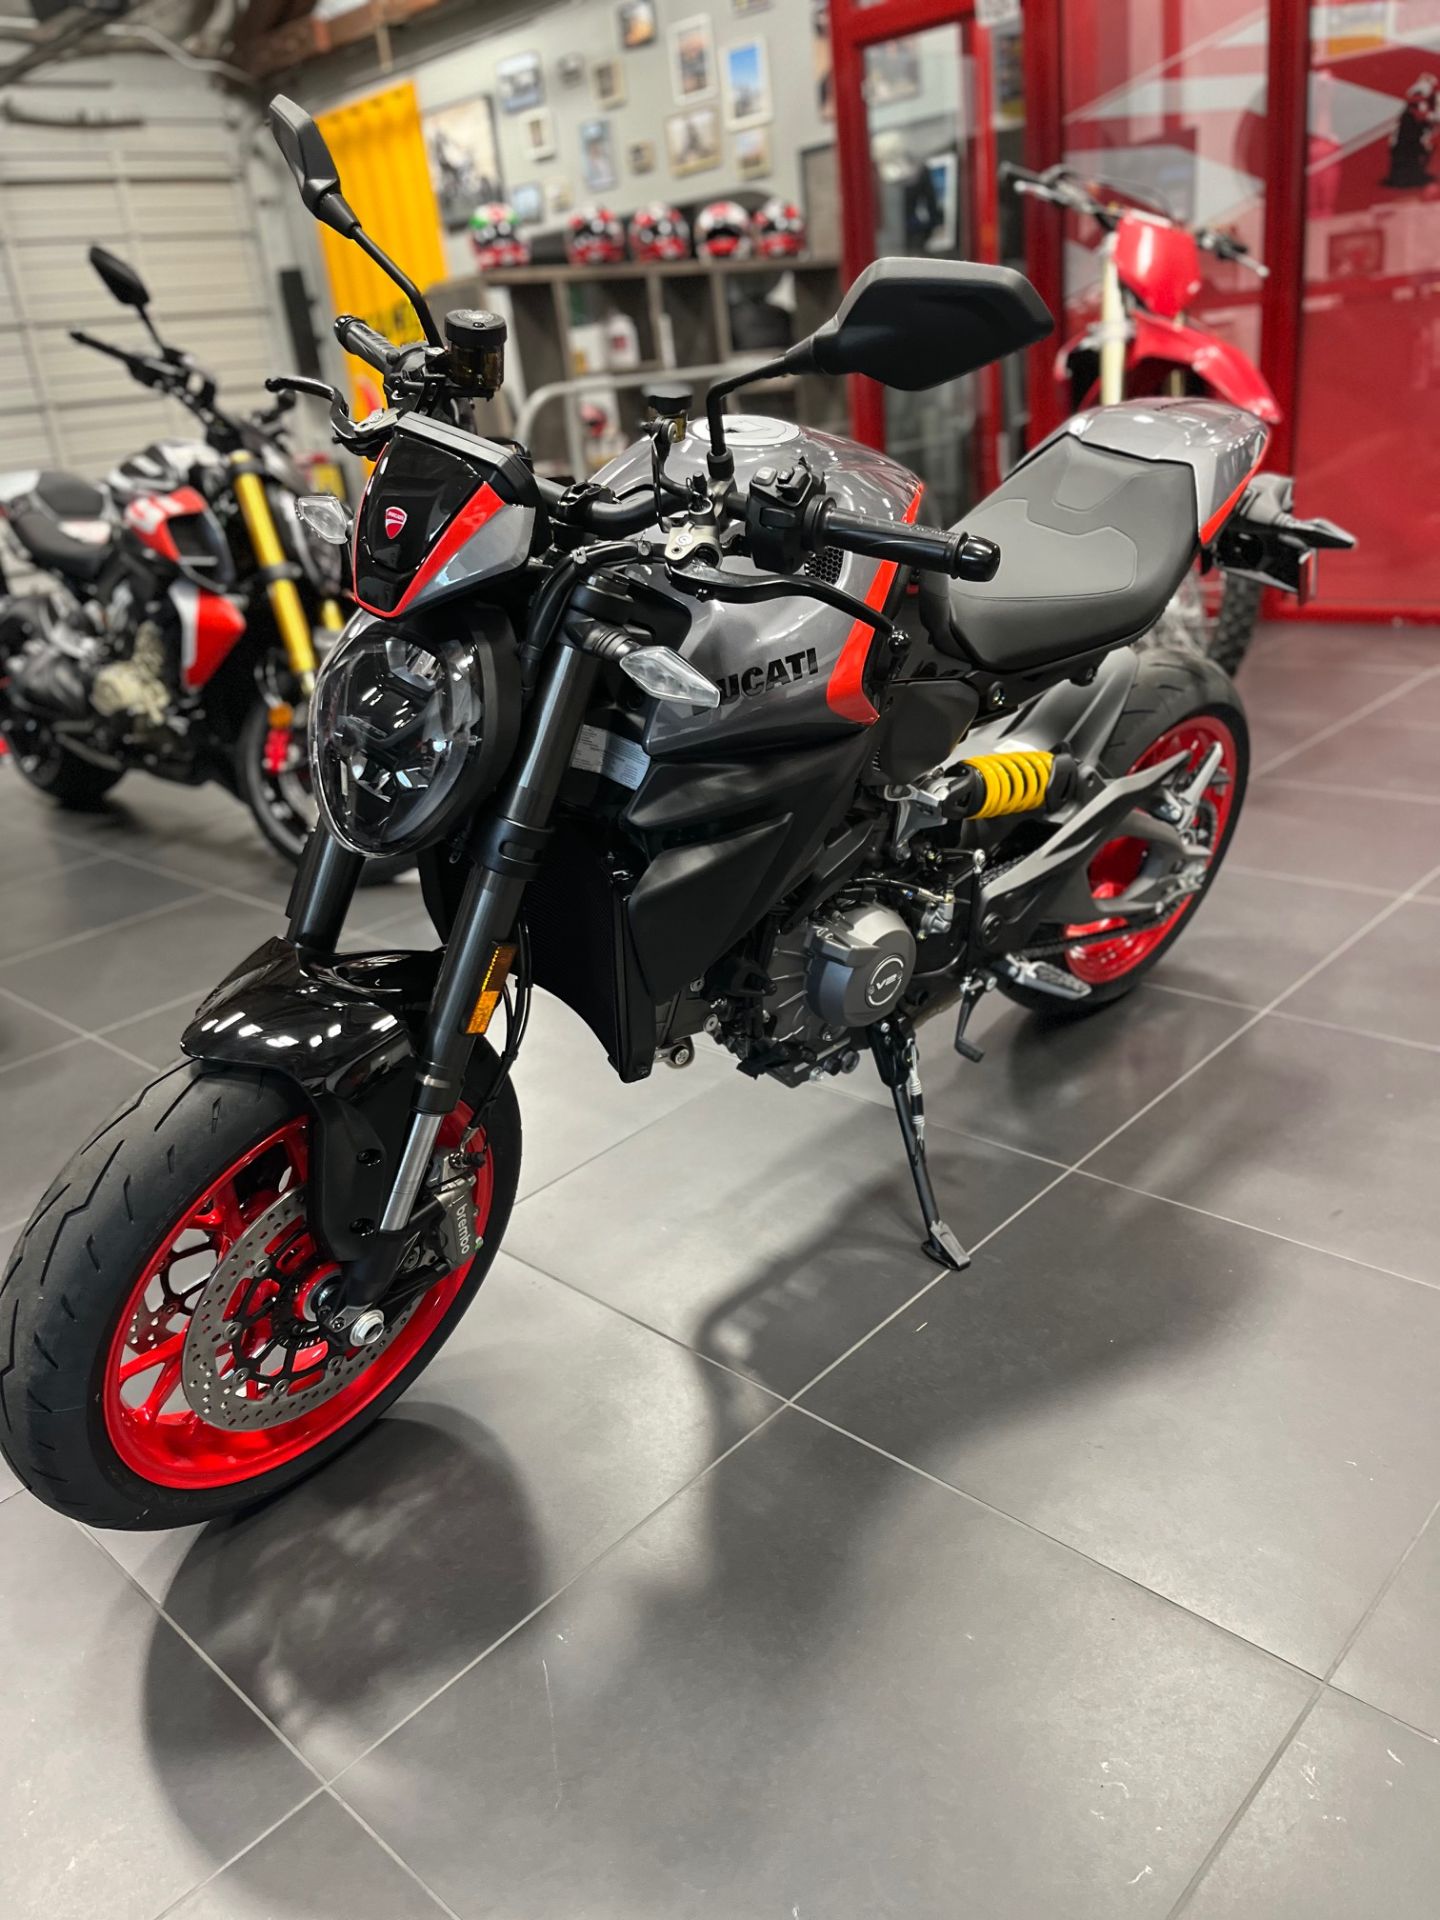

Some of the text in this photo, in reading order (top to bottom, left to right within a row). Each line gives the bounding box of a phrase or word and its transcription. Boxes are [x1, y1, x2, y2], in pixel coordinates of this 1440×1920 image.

[693, 648, 818, 716] UCATI
[876, 973, 898, 990] V2
[456, 1203, 471, 1255] brembo
